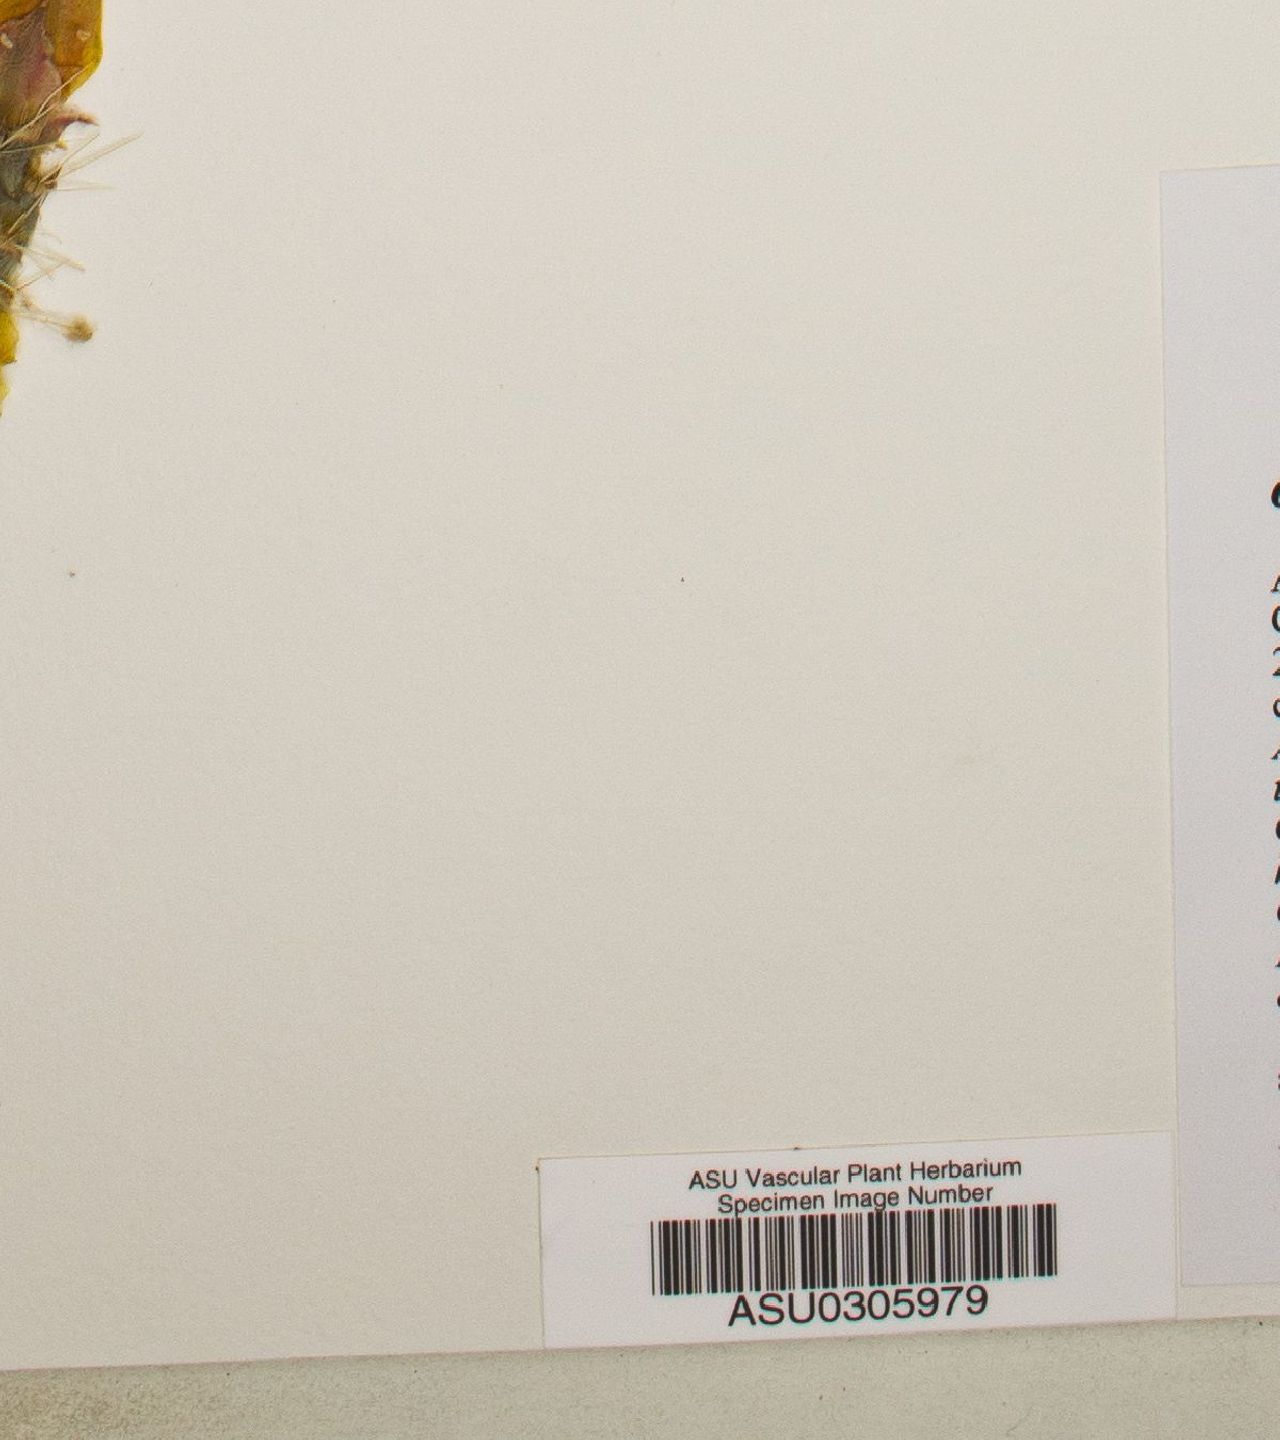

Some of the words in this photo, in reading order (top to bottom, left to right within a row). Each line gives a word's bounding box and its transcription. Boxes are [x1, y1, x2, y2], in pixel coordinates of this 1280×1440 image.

[689, 1169, 736, 1189] ASU
[745, 1167, 839, 1187] Vascular
[849, 1164, 901, 1182] Plant
[911, 1159, 1021, 1180] Herbarium
[719, 1192, 824, 1218] Specimen
[835, 1189, 899, 1211] Image
[909, 1184, 993, 1204] Number
[729, 1285, 988, 1326] ASU0305979
